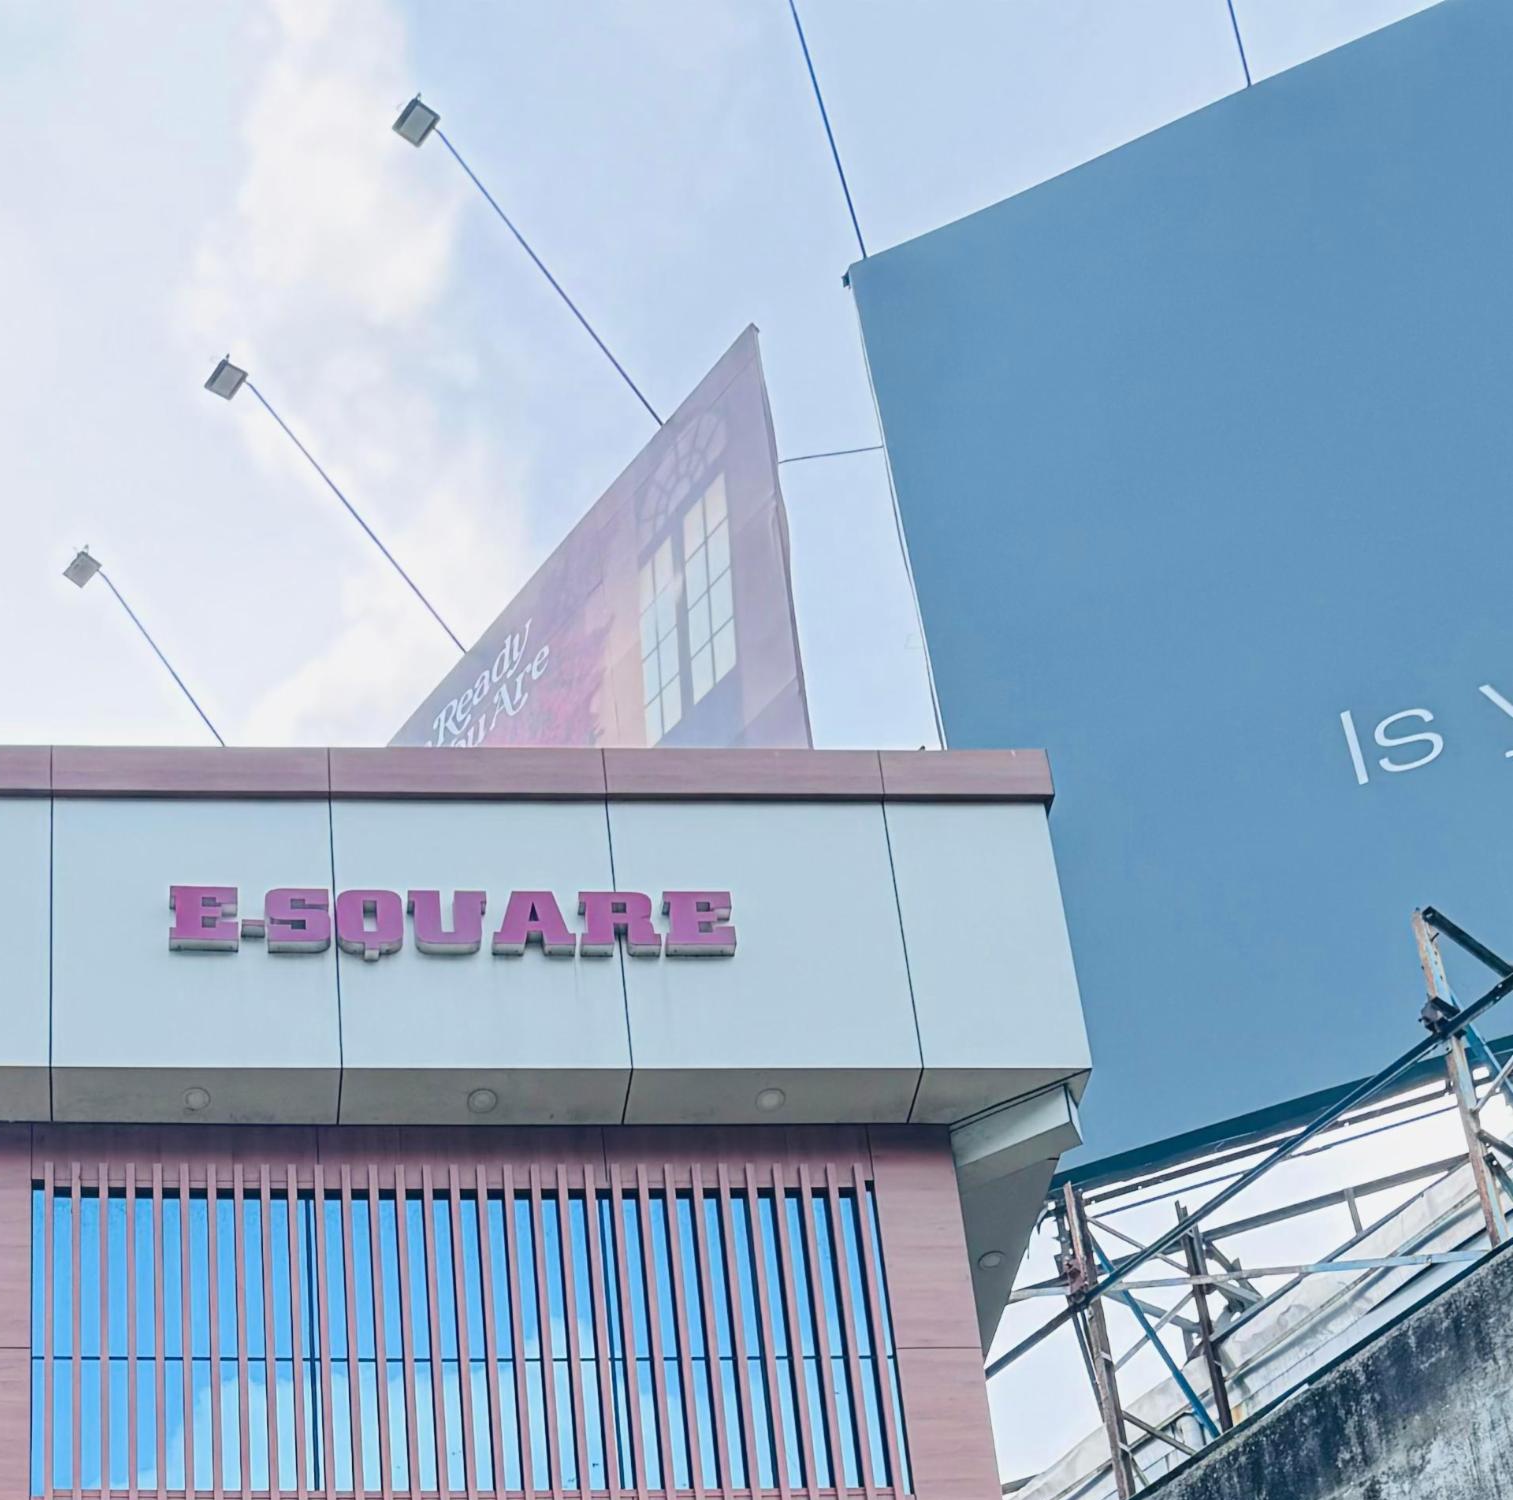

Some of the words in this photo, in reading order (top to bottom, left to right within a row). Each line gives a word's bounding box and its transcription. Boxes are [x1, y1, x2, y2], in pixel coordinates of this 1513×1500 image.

[433, 617, 532, 747] Ready
[489, 645, 550, 731] Are
[169, 885, 737, 961] E-SQUARE
